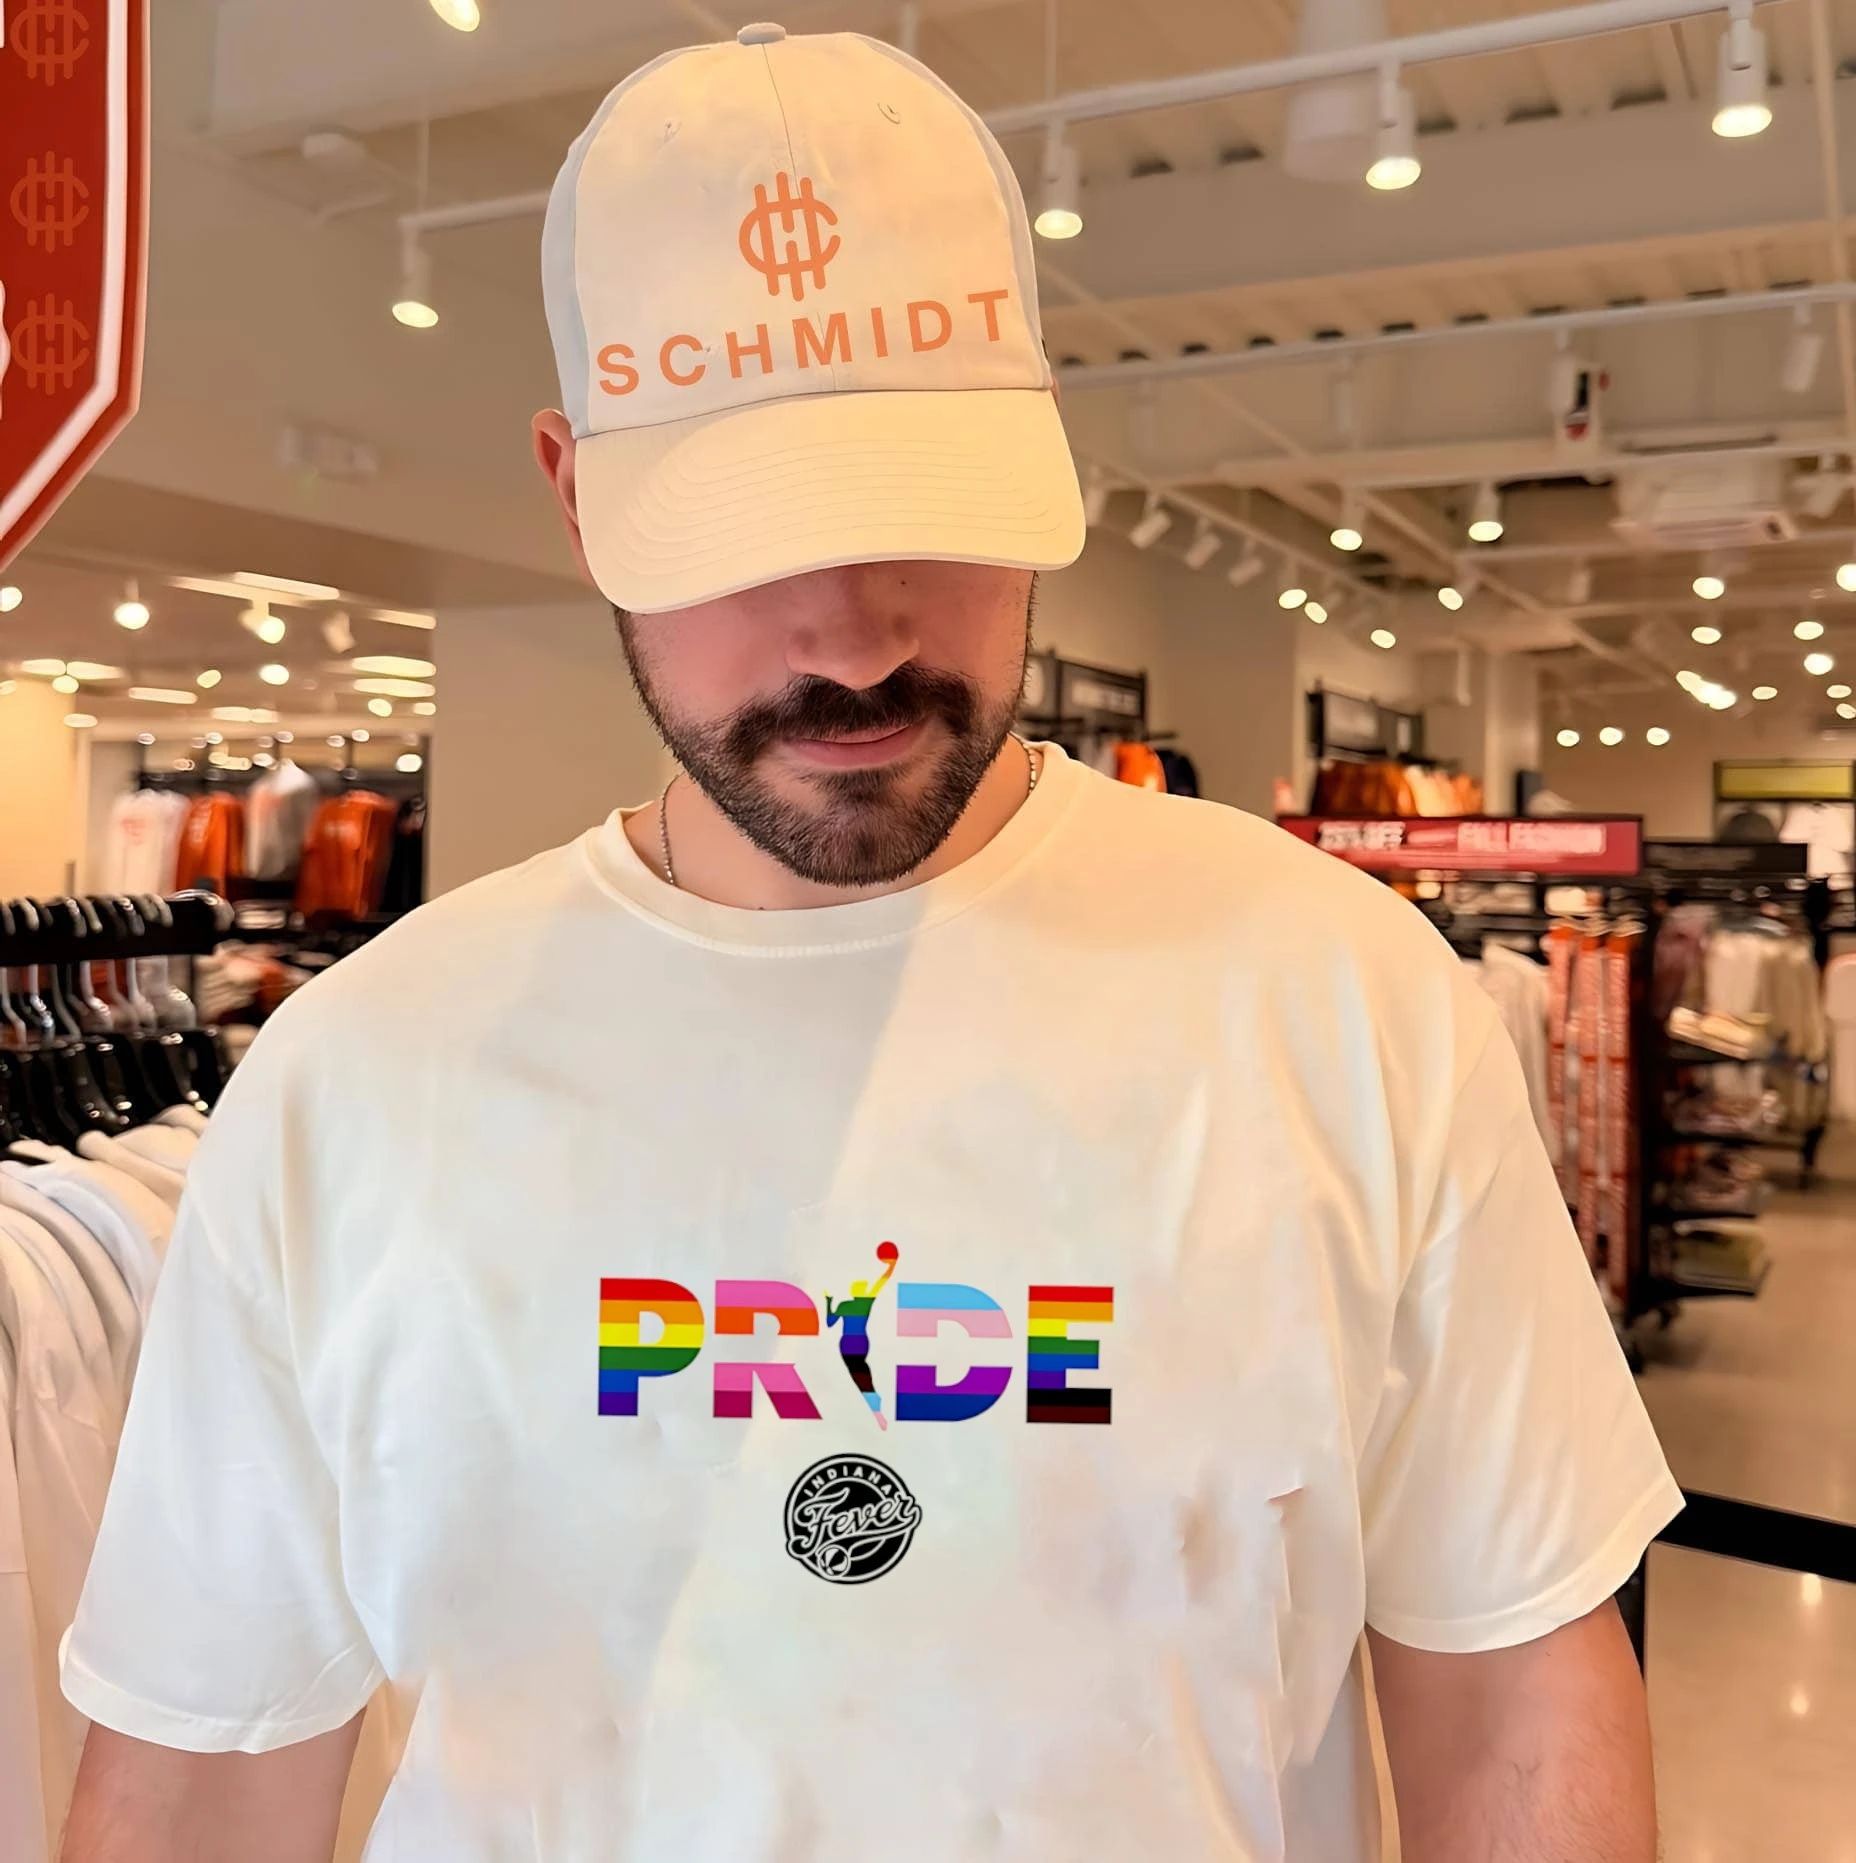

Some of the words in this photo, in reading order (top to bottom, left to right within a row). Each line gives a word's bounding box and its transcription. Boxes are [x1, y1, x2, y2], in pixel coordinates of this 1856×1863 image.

[597, 289, 1008, 395] SCHMIDT
[803, 1464, 893, 1498] INDIANA
[788, 1487, 921, 1558] Fever
